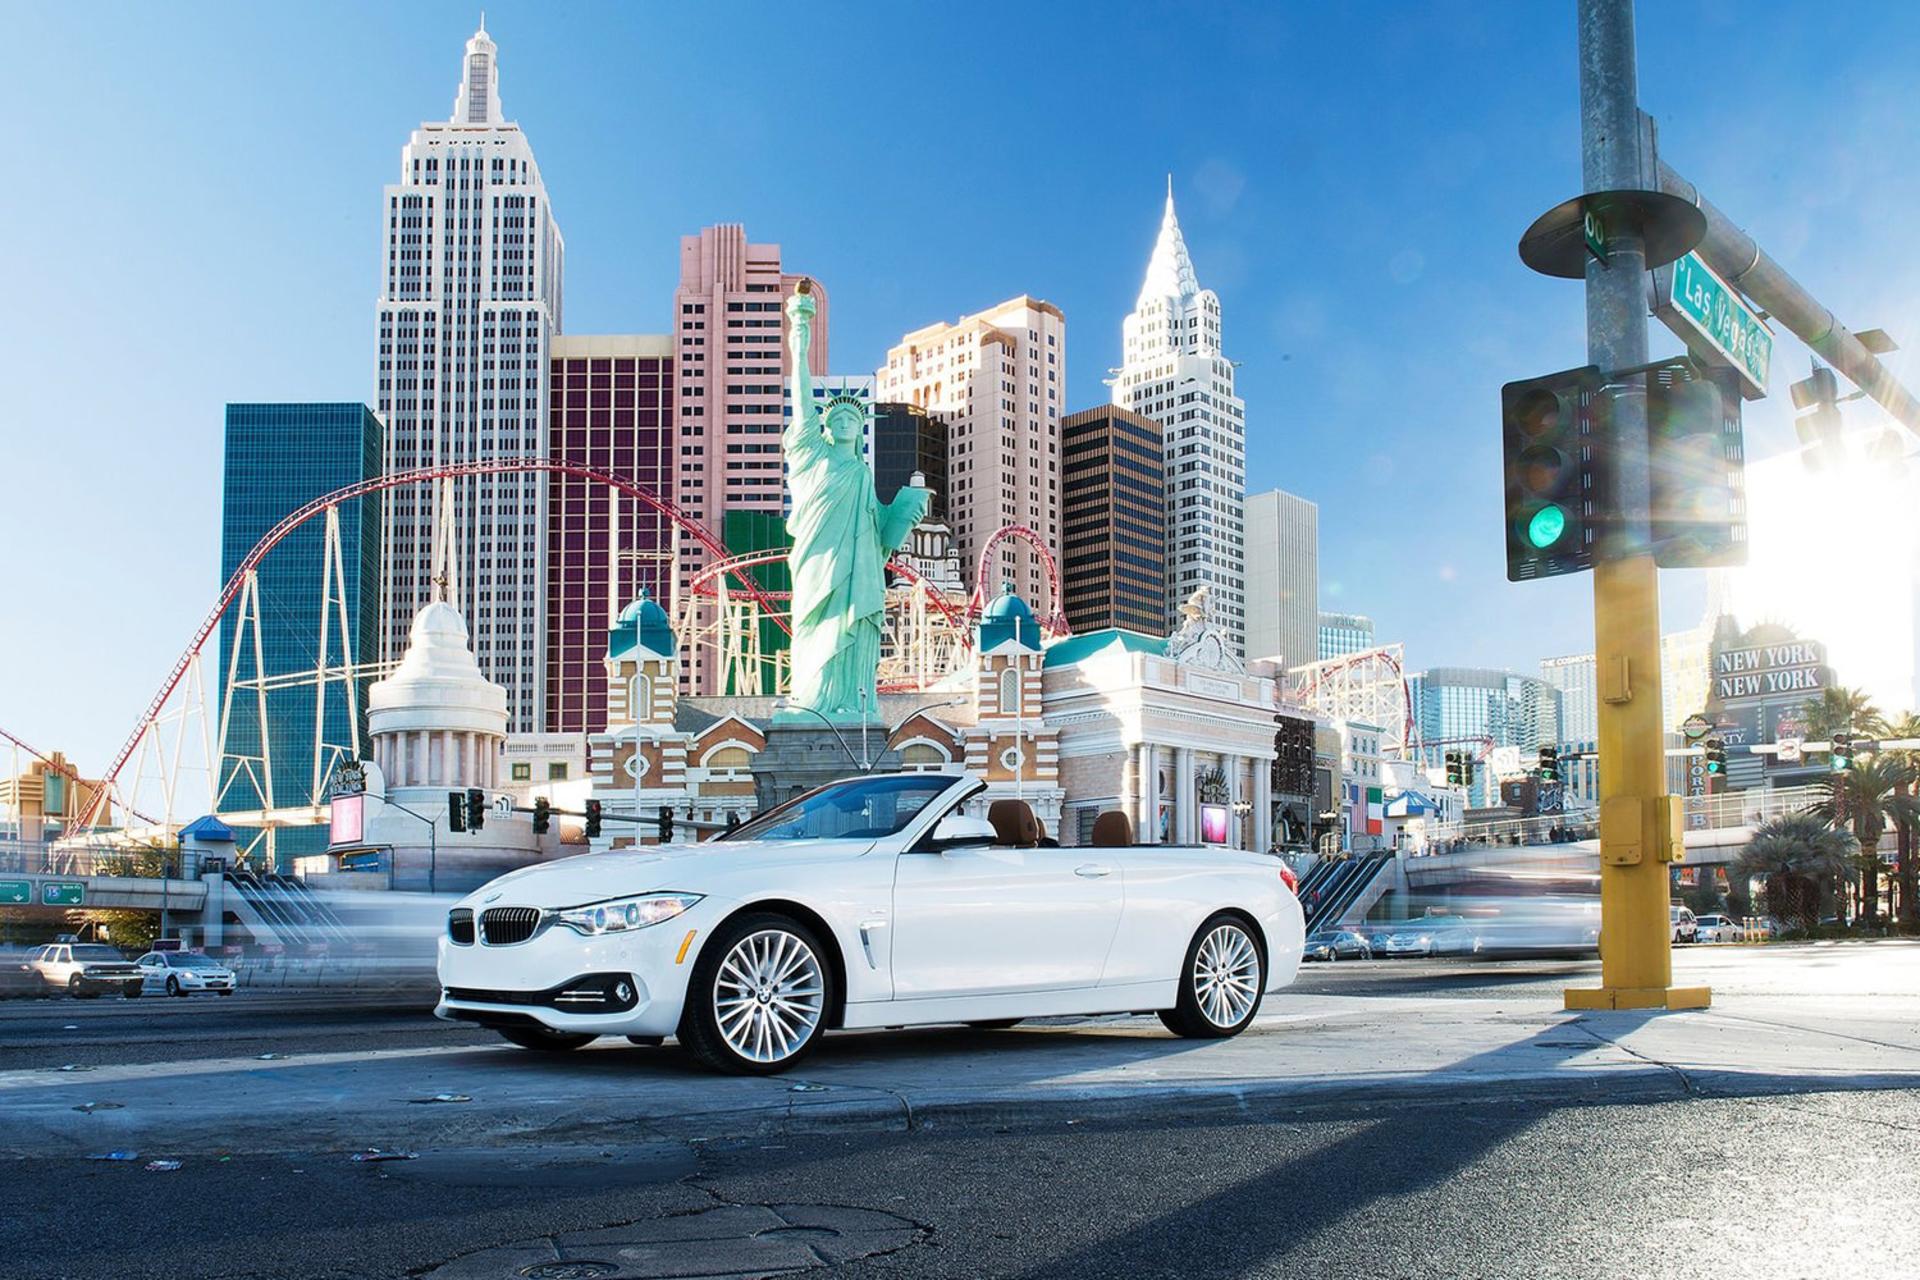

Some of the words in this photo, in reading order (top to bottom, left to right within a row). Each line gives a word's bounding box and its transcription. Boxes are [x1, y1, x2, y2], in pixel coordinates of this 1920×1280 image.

[1685, 267, 1711, 315] Las
[1715, 295, 1755, 358] Vegas
[1720, 650, 1760, 672] NEW
[1766, 643, 1817, 666] YORK
[1720, 675, 1761, 697] NEW
[1766, 668, 1818, 691] YORK
